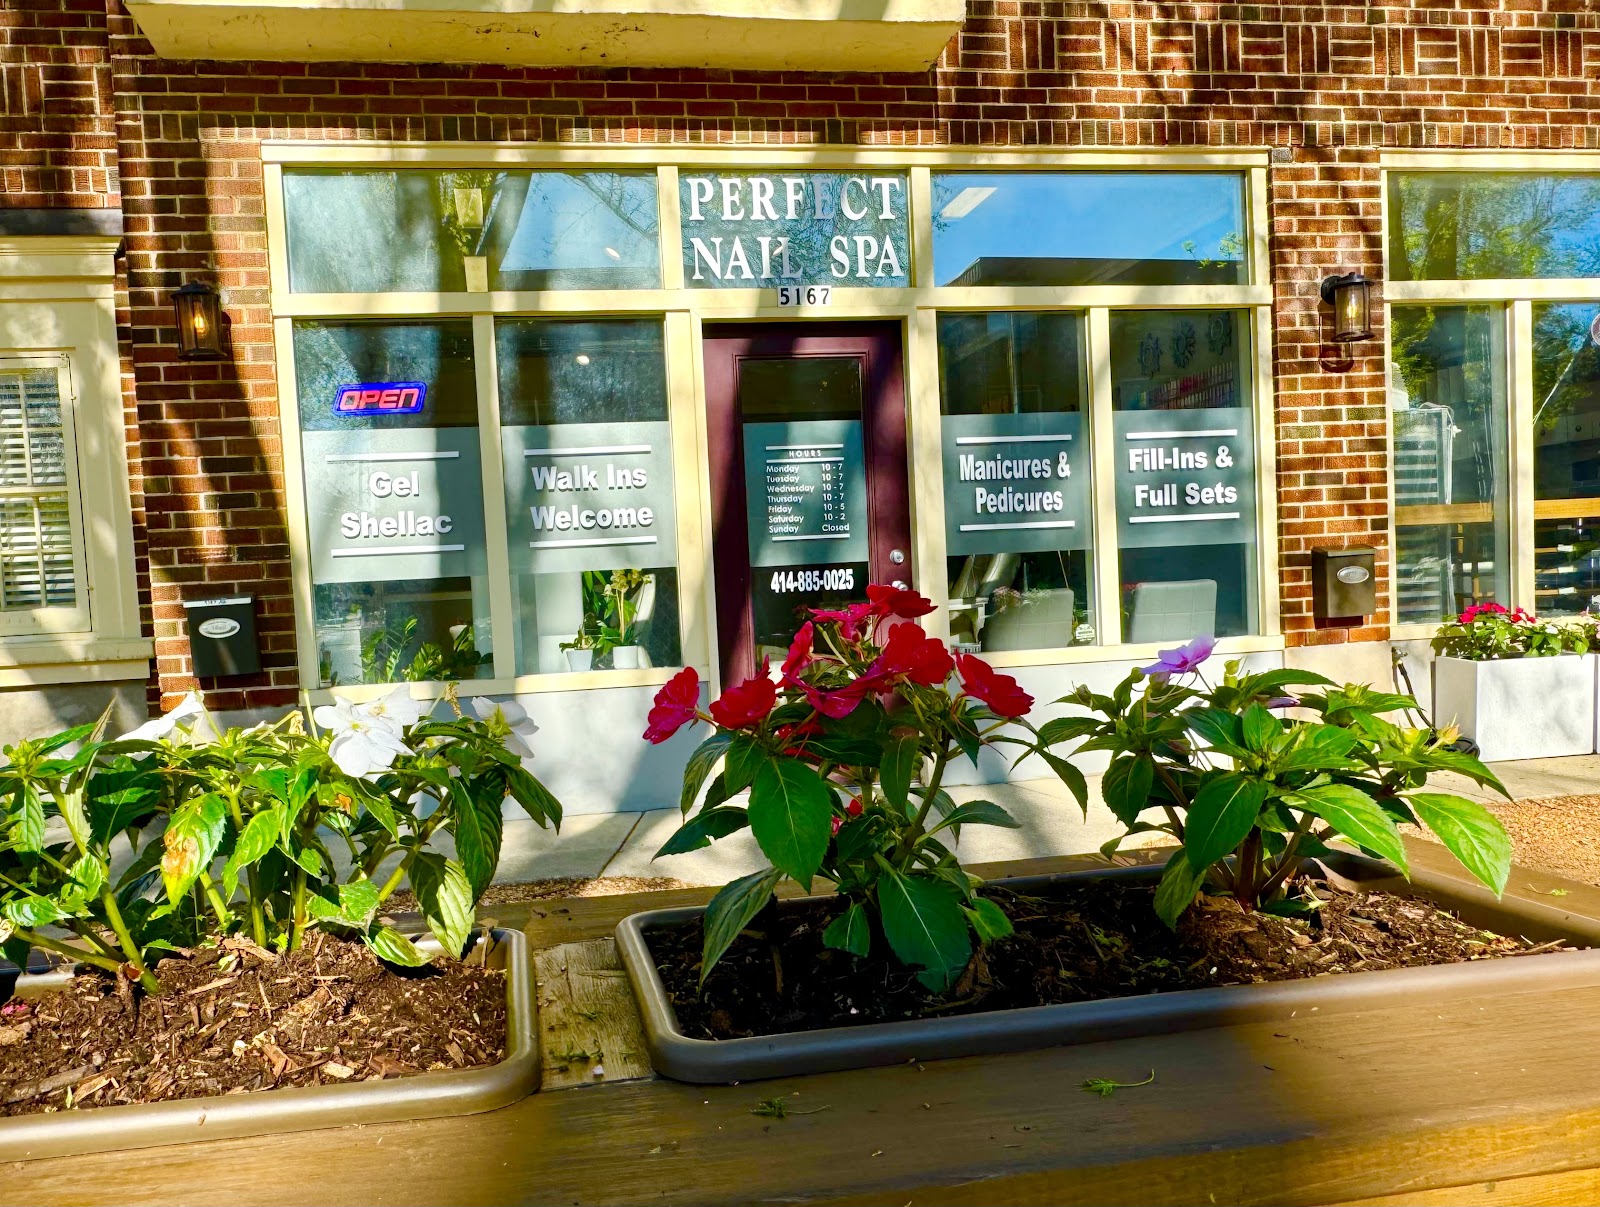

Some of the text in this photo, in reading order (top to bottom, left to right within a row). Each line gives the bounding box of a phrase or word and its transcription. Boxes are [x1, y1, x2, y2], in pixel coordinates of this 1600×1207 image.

[686, 176, 900, 221] PERFECT
[690, 234, 905, 280] NAIL SPA
[780, 288, 830, 306] 5167
[339, 388, 419, 411] OPEN
[766, 465, 800, 474] Monday
[959, 451, 1071, 481] Manicures &
[1128, 445, 1234, 472] Fill-Ins &
[369, 470, 420, 498] Gel
[532, 464, 648, 492] Walk Ins
[766, 475, 800, 483] Tuesday
[767, 485, 814, 493] Wednesday
[768, 495, 803, 504] Thursday
[975, 486, 1064, 514] Pedicures
[1134, 482, 1238, 507] Full Sets
[530, 505, 654, 531] Welcome
[768, 506, 792, 514] Friday
[768, 515, 804, 523] Saturday
[340, 511, 452, 539] Shellac
[769, 523, 850, 533] Sunday Closed
[770, 568, 854, 593] 414-885-0025
